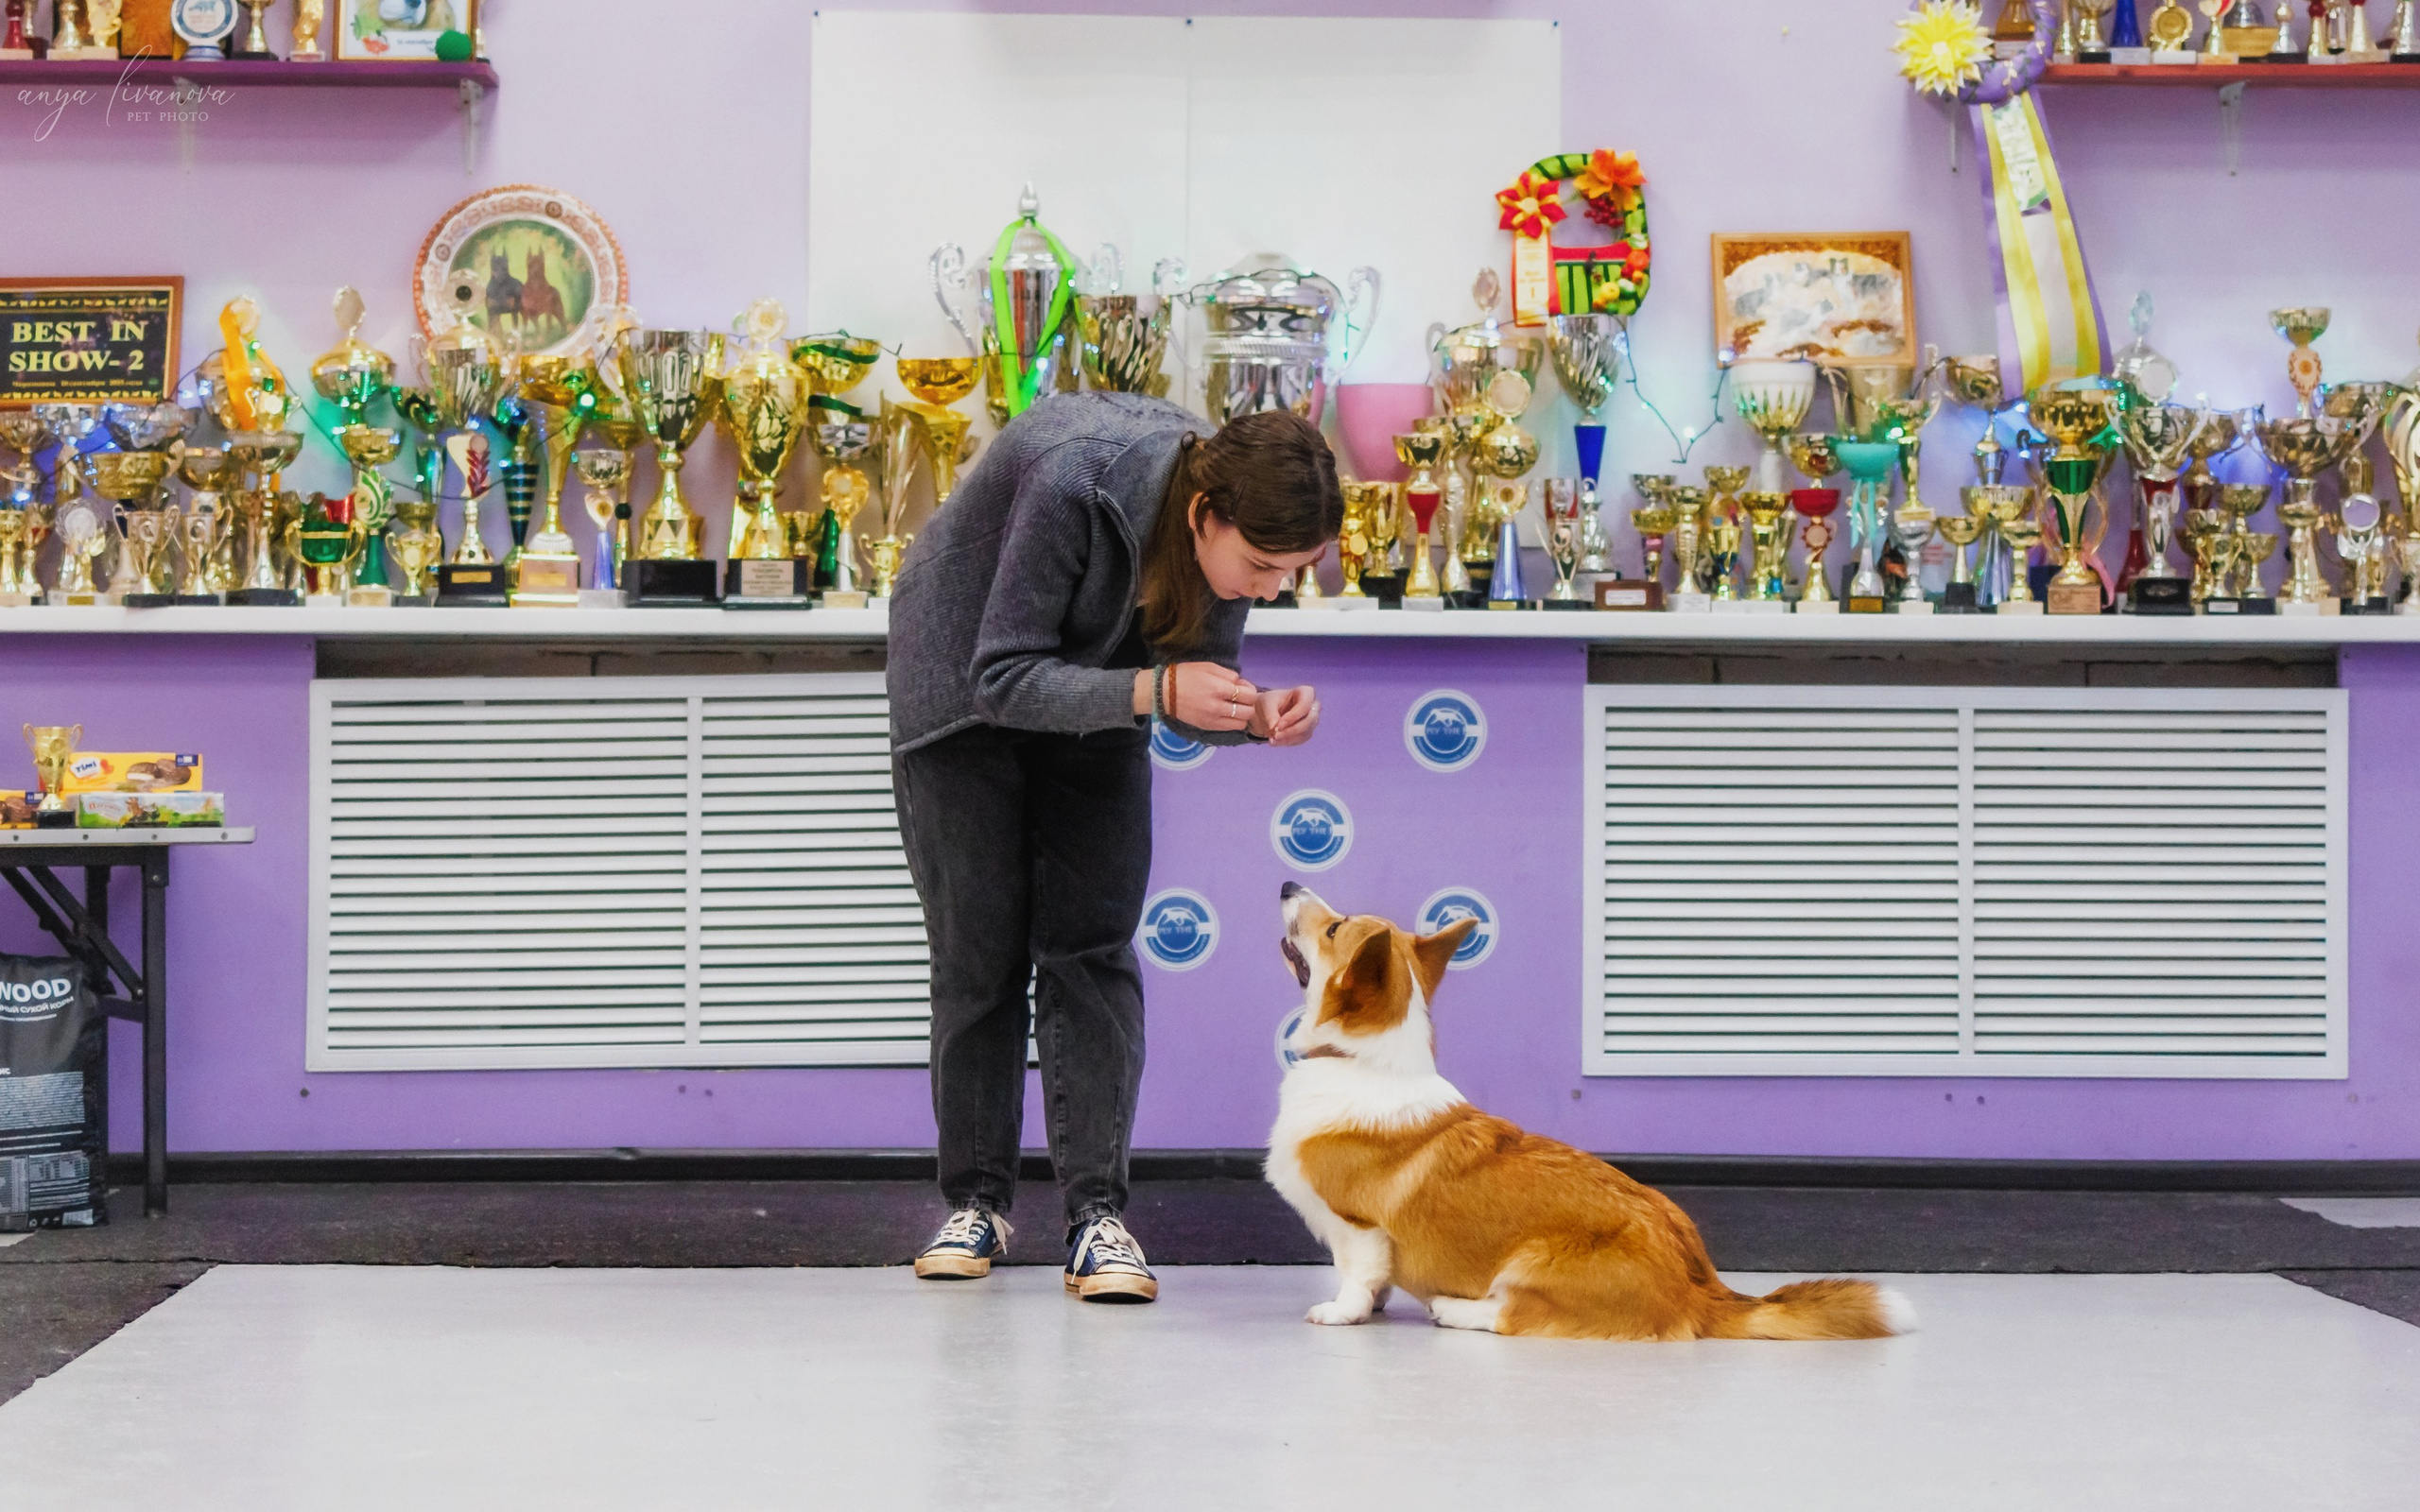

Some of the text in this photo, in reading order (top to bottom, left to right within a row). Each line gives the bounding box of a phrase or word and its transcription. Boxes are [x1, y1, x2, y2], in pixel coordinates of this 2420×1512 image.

[10, 319, 149, 343] BEST IN
[9, 349, 145, 372] SHOW- 2
